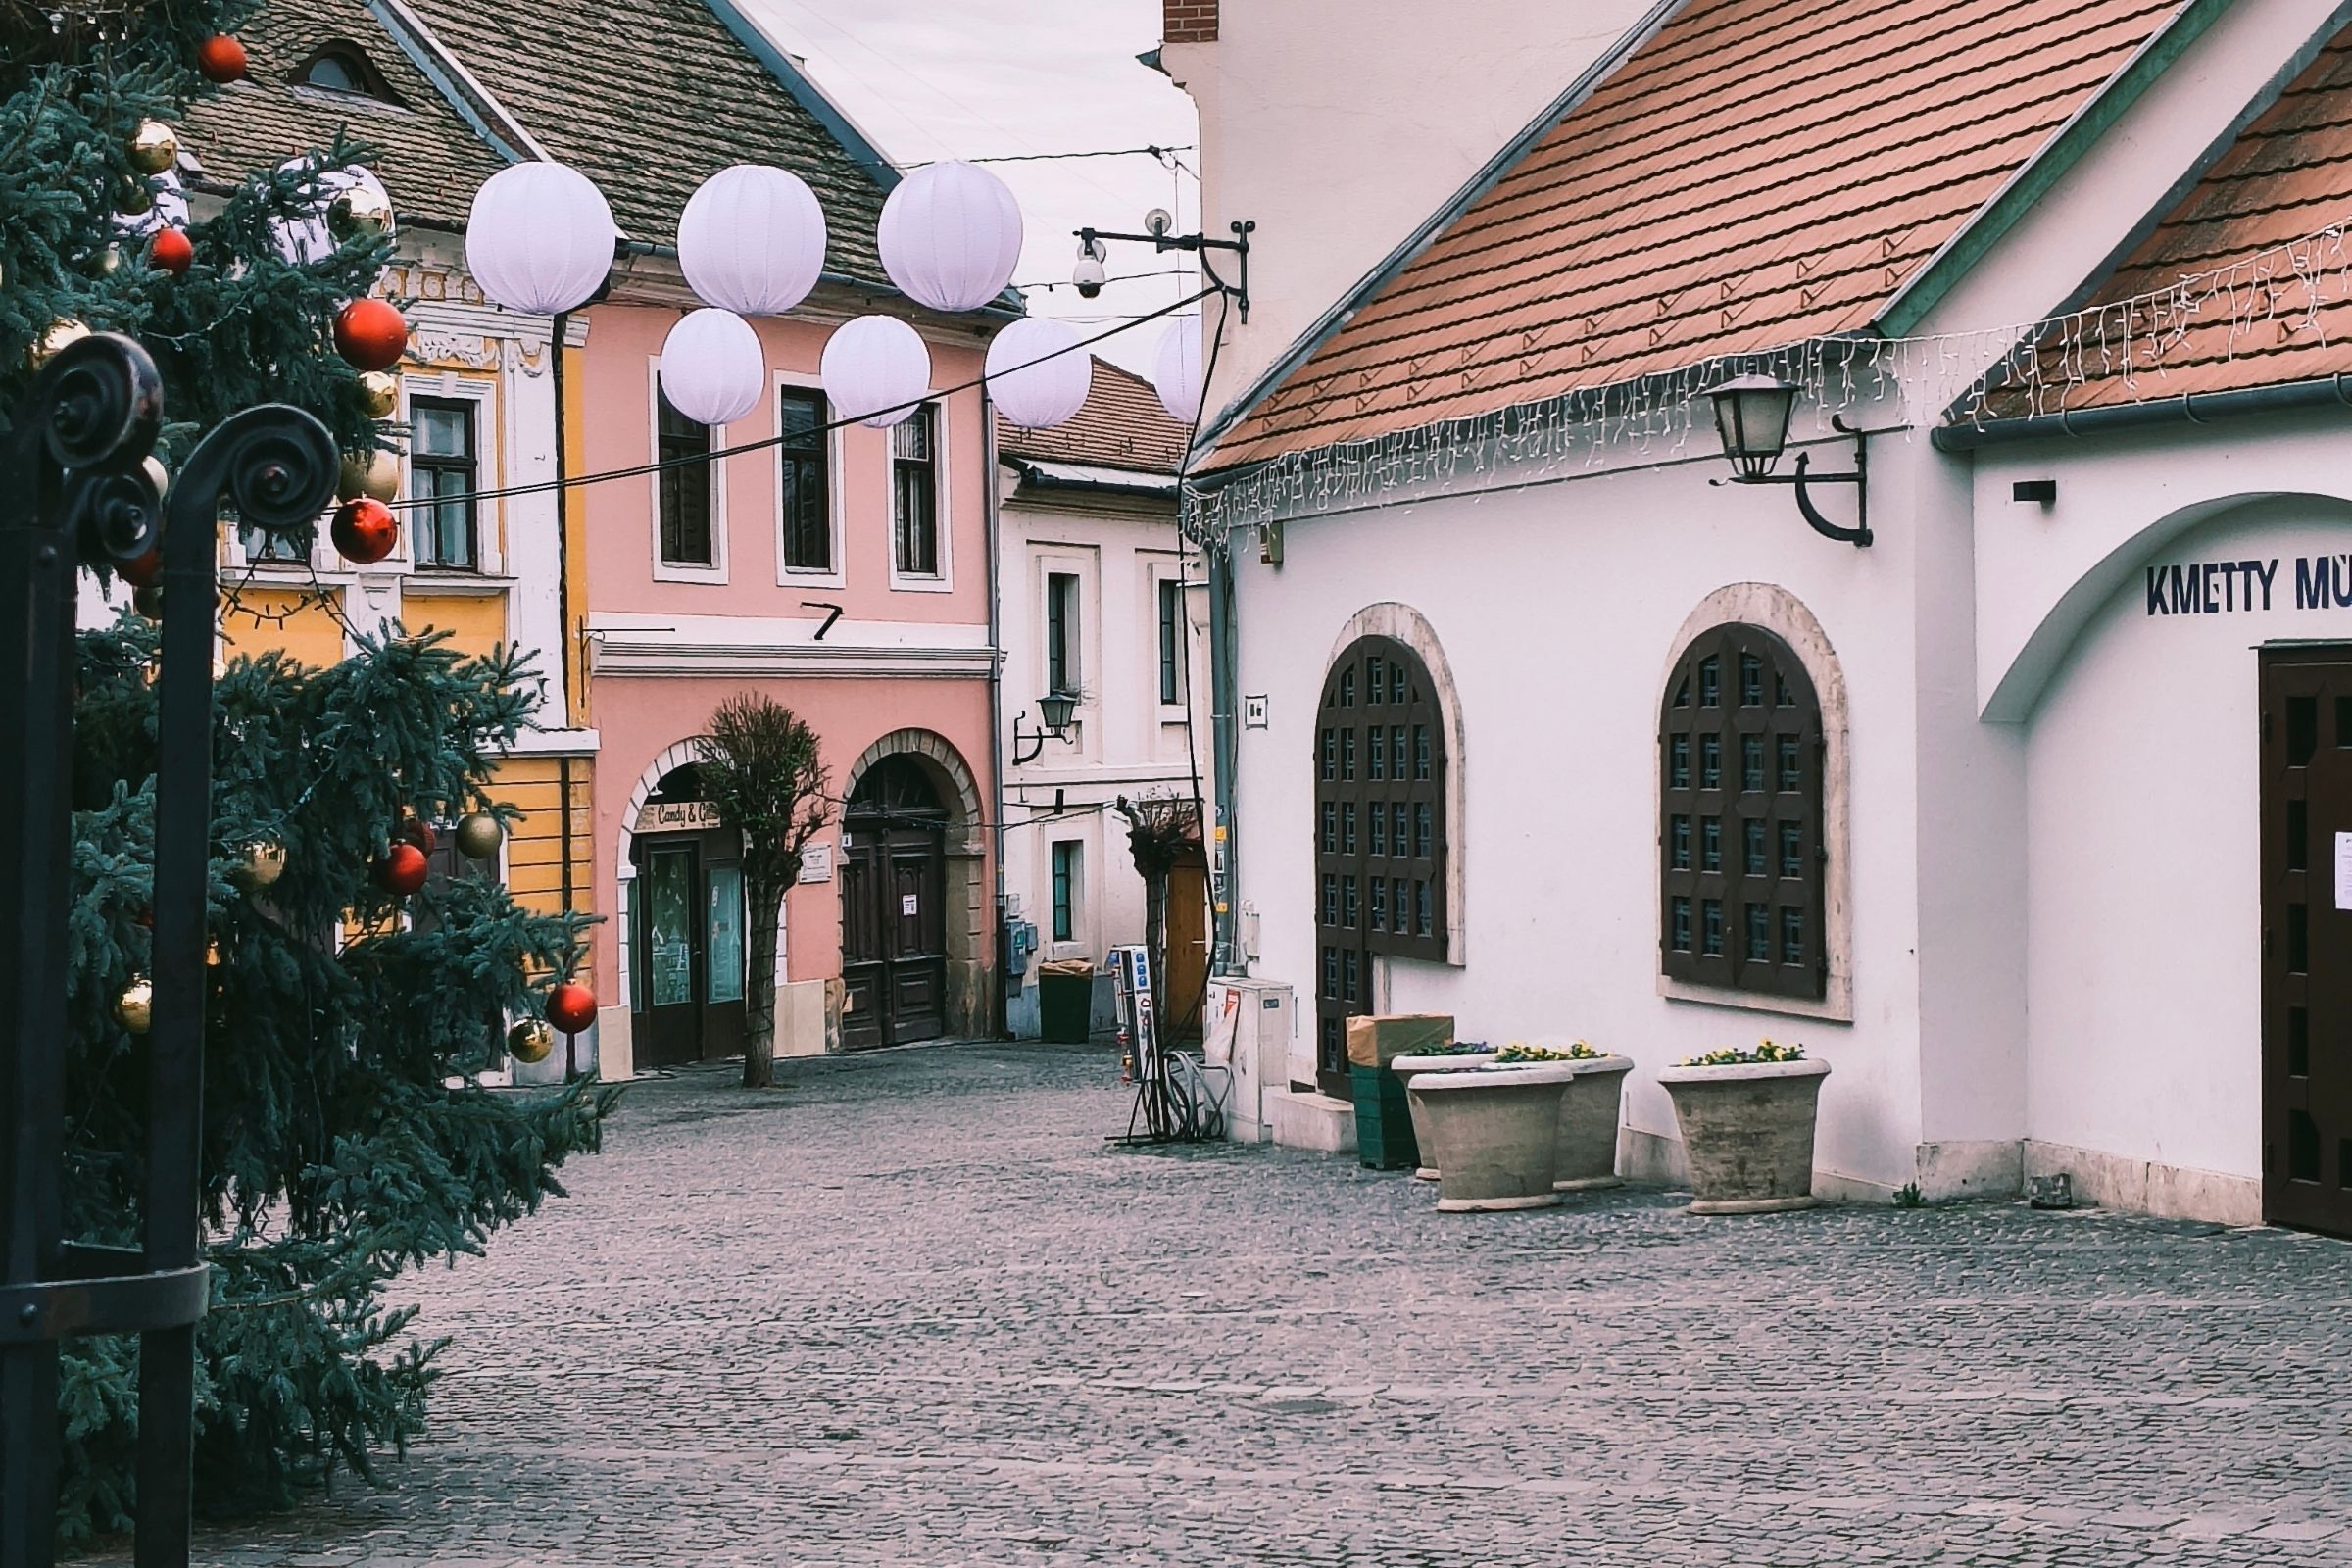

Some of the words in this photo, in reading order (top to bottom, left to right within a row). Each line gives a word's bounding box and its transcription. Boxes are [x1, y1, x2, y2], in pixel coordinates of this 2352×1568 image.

[2147, 559, 2278, 615] KMETTY
[658, 804, 686, 827] Candy
[688, 803, 697, 822] &
